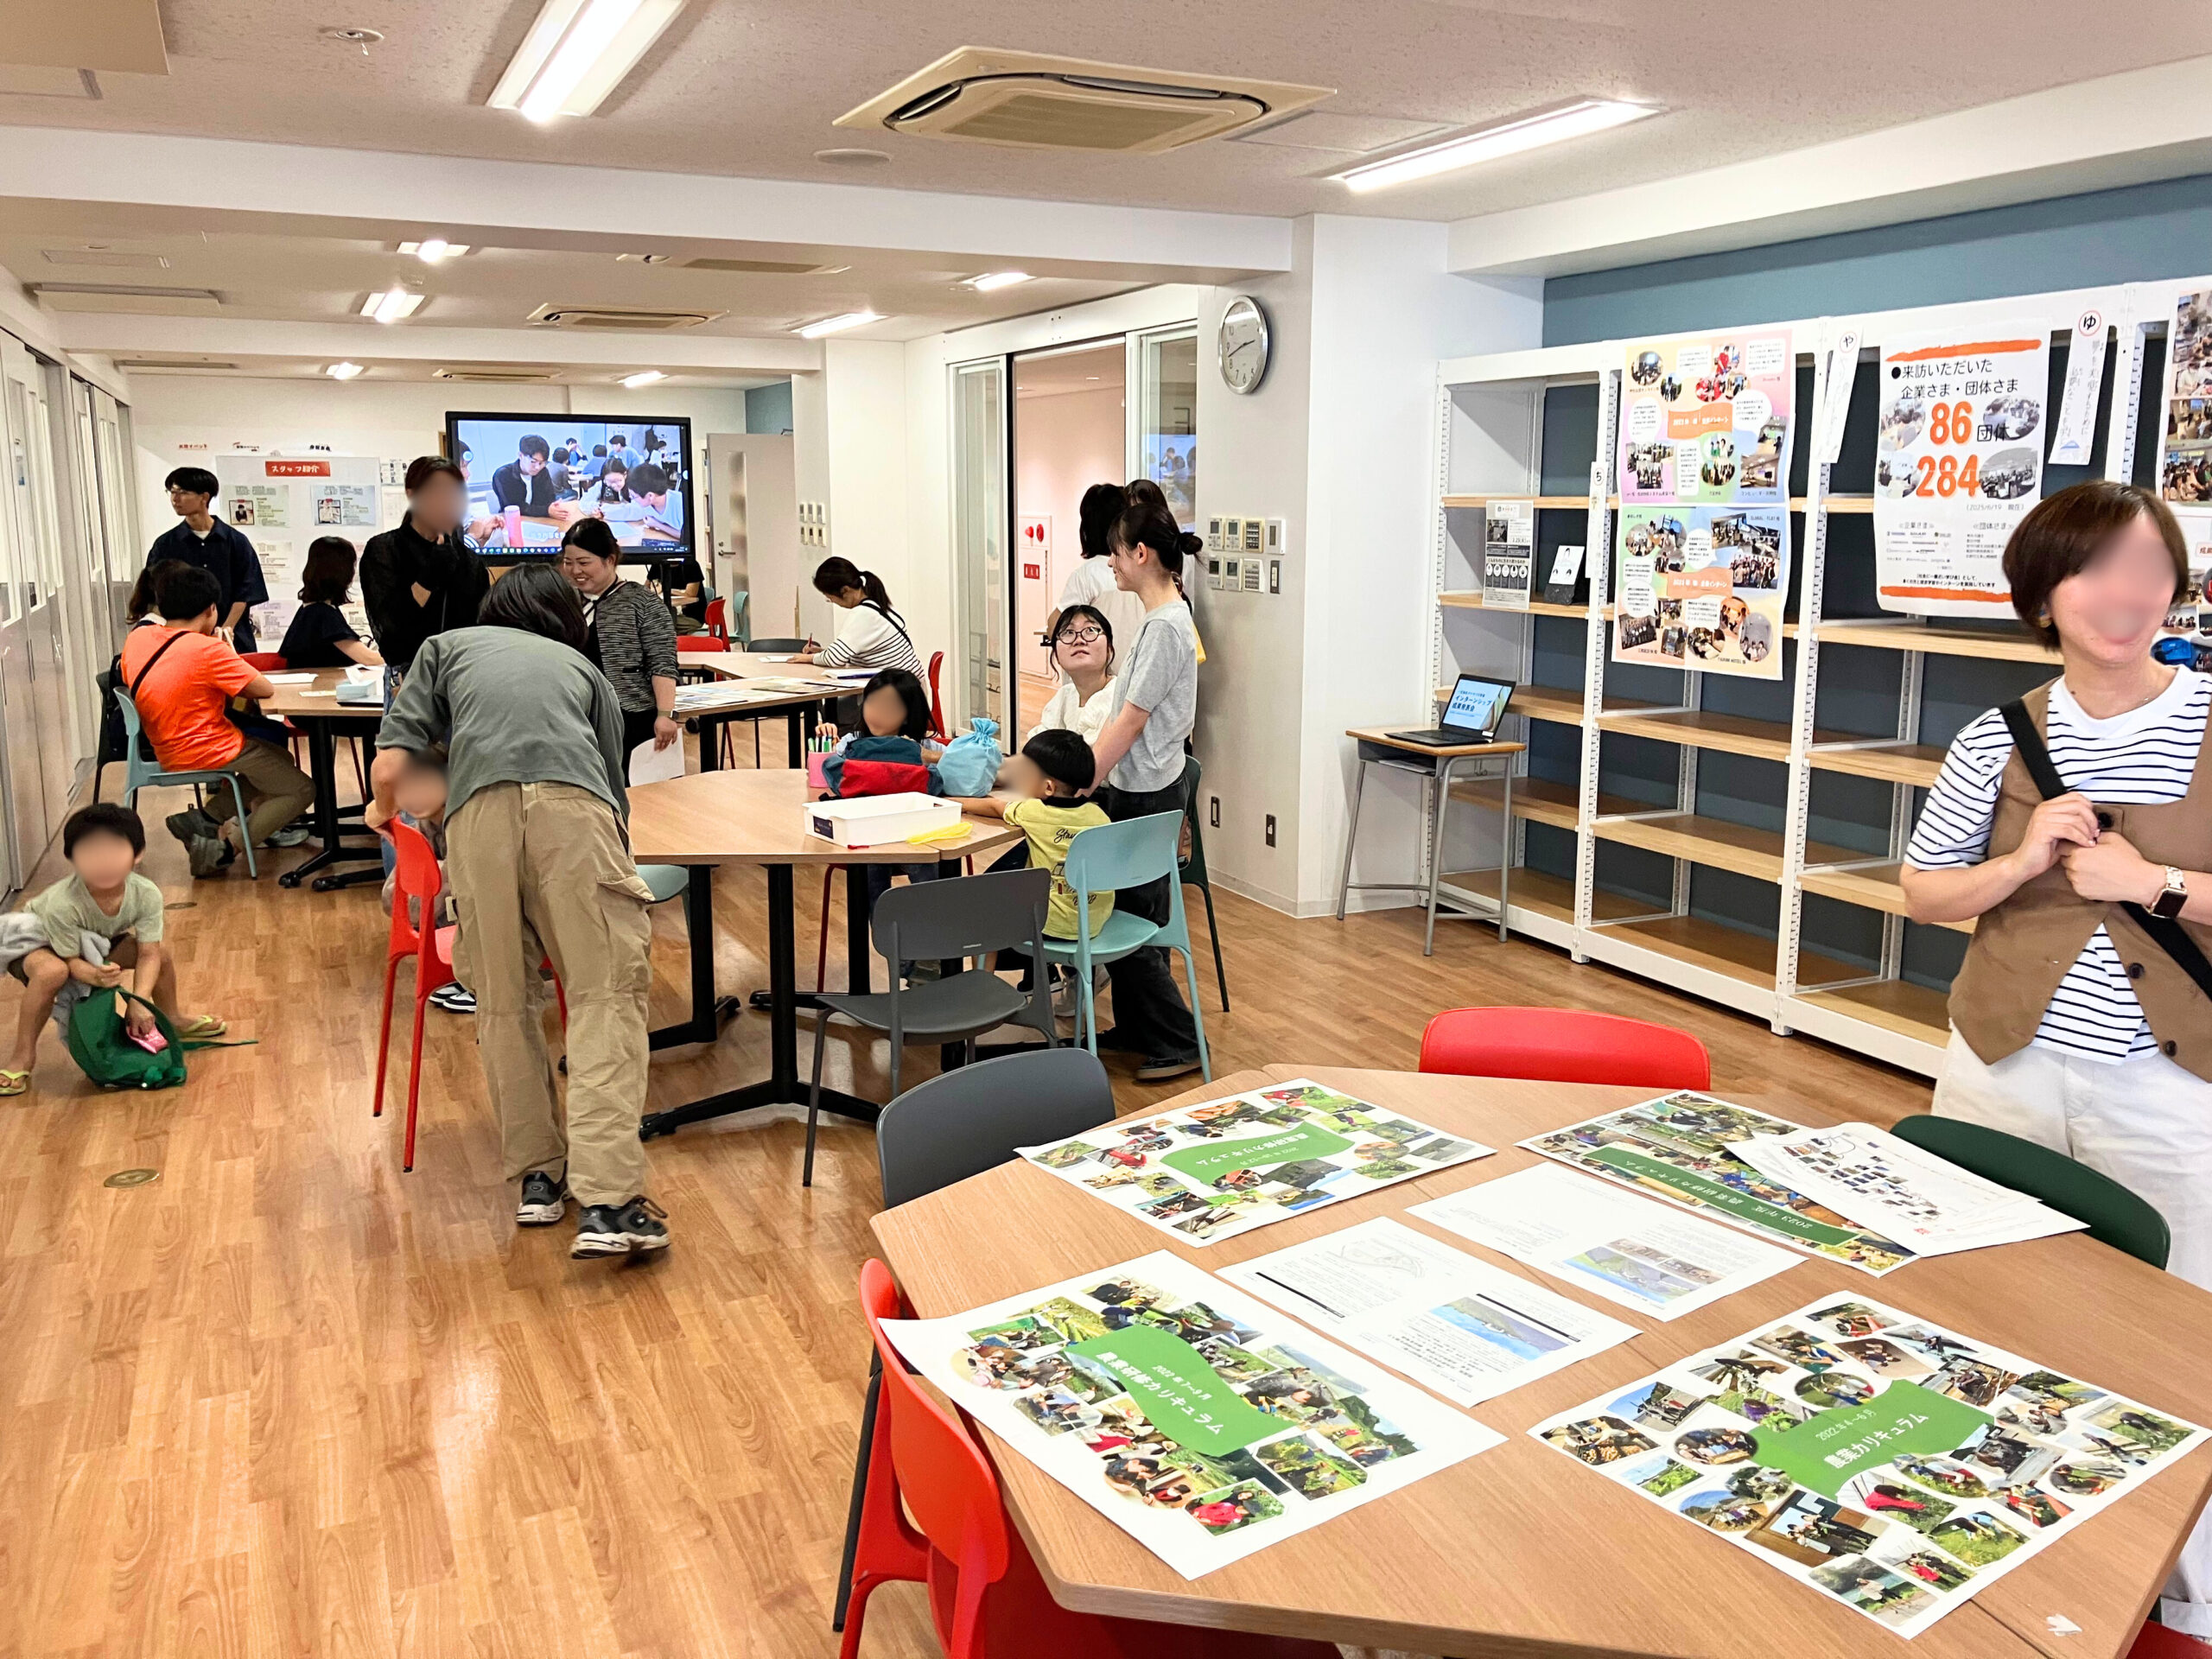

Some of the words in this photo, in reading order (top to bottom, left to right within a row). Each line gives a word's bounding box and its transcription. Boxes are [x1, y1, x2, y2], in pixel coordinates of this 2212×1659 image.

[2083, 315, 2096, 331] ゆ
[1843, 335, 1853, 347] や
[1902, 378, 2018, 399] 企業さま・団体さま
[1929, 401, 1973, 445] 86
[1977, 423, 2009, 442] 団体
[271, 465, 320, 474] スタッフ紹介
[1596, 471, 1602, 481] ち
[1916, 454, 1980, 498] 284
[1455, 695, 1493, 706] インターンシップ
[1096, 1351, 1224, 1435] 農業研修カリキュラム
[1823, 1413, 1929, 1469] 農業カリキュラム
